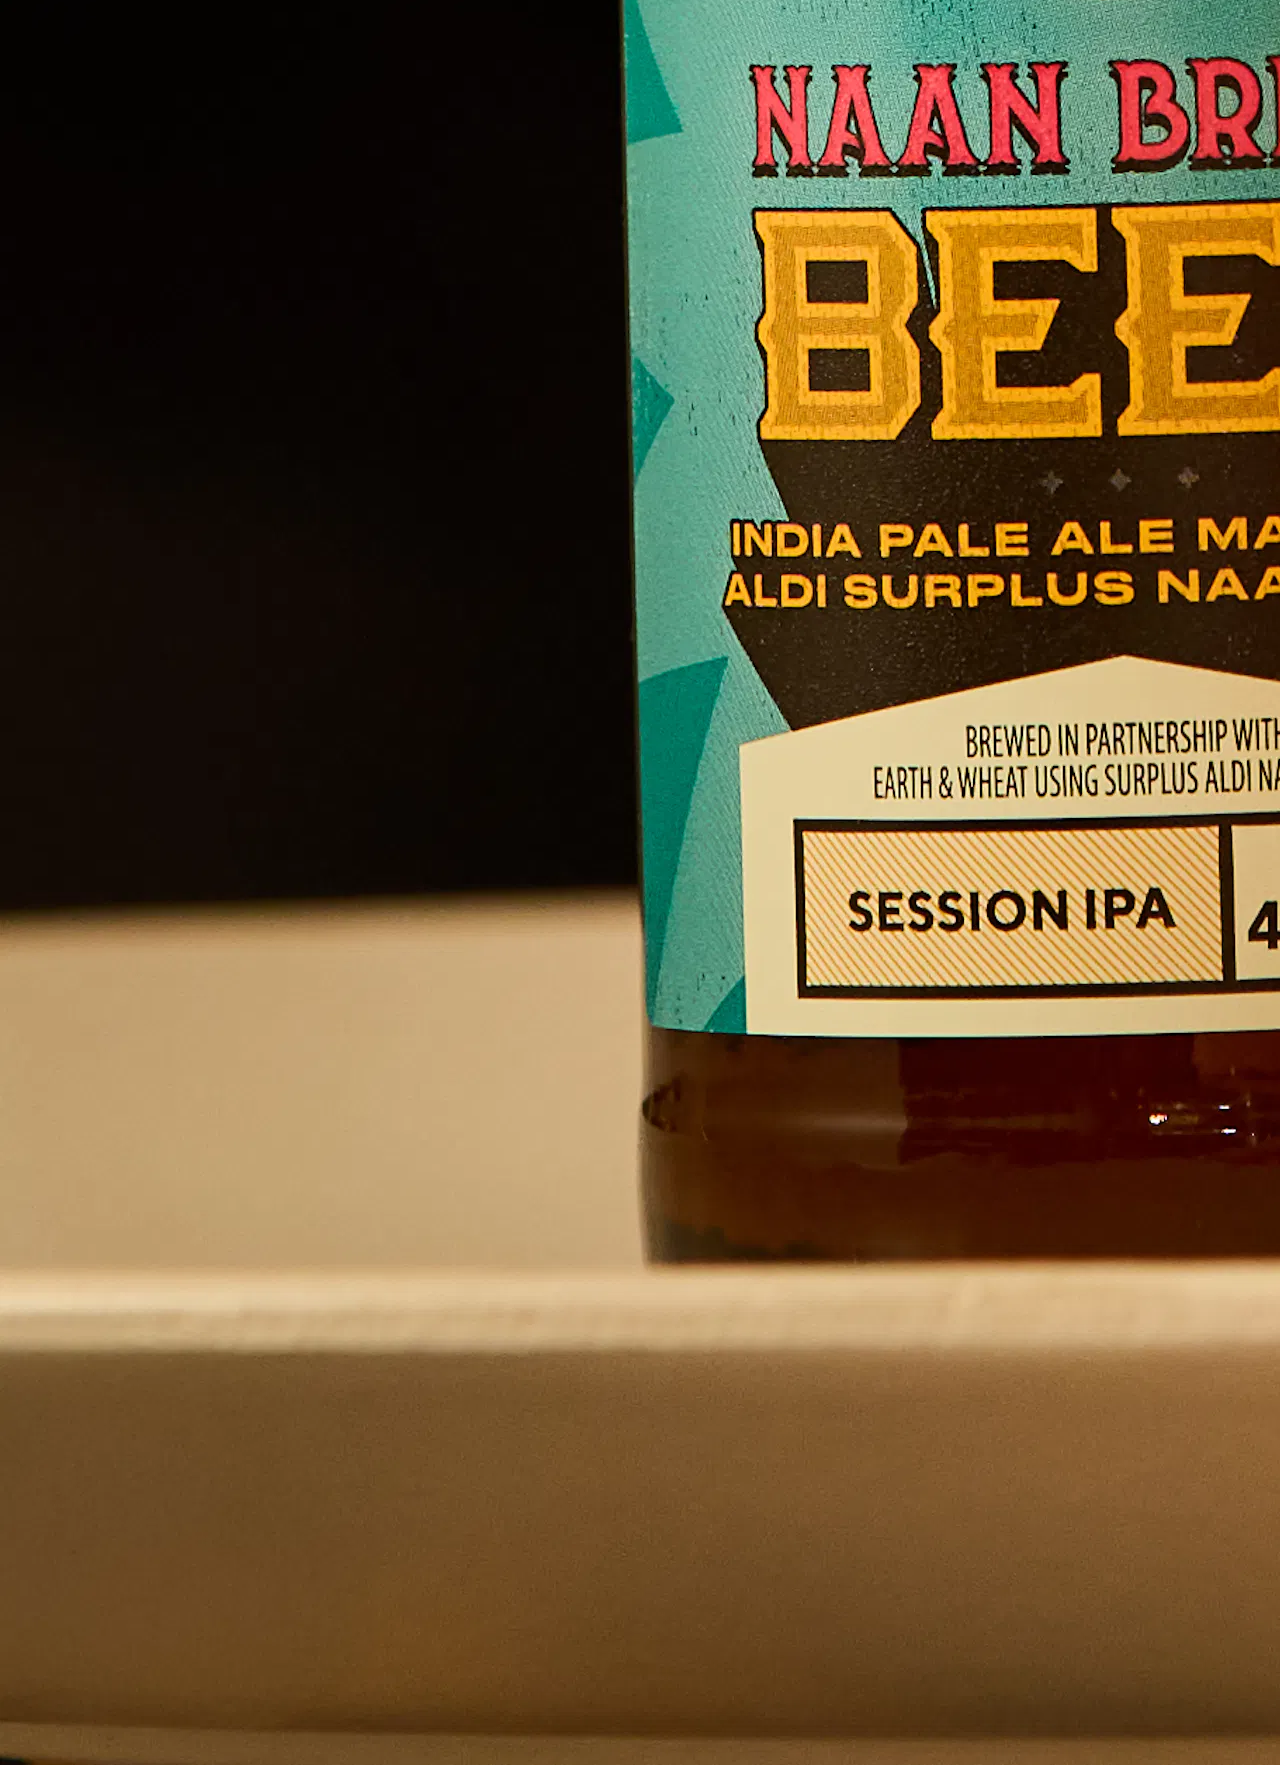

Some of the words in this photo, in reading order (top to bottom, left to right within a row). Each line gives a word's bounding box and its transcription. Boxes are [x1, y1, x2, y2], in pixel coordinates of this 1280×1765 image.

[750, 60, 1070, 177] NAAN
[730, 521, 863, 559] INDIA
[879, 521, 1031, 559] PALE
[1050, 518, 1176, 556] ALE
[723, 572, 828, 609] ALDI
[843, 569, 1137, 610] SURPLUS
[965, 723, 1051, 758] BREWED
[1057, 722, 1080, 757] IN
[1085, 718, 1228, 756] PARTNERSHIP
[873, 765, 933, 800] EARTH
[938, 766, 955, 799] &
[956, 764, 1029, 799] WHEAT
[1034, 763, 1099, 798] USING
[1104, 761, 1199, 797] SURPLUS
[1204, 758, 1253, 794] ALDI
[847, 888, 1069, 933] SESSION
[1086, 886, 1178, 930] IPA
